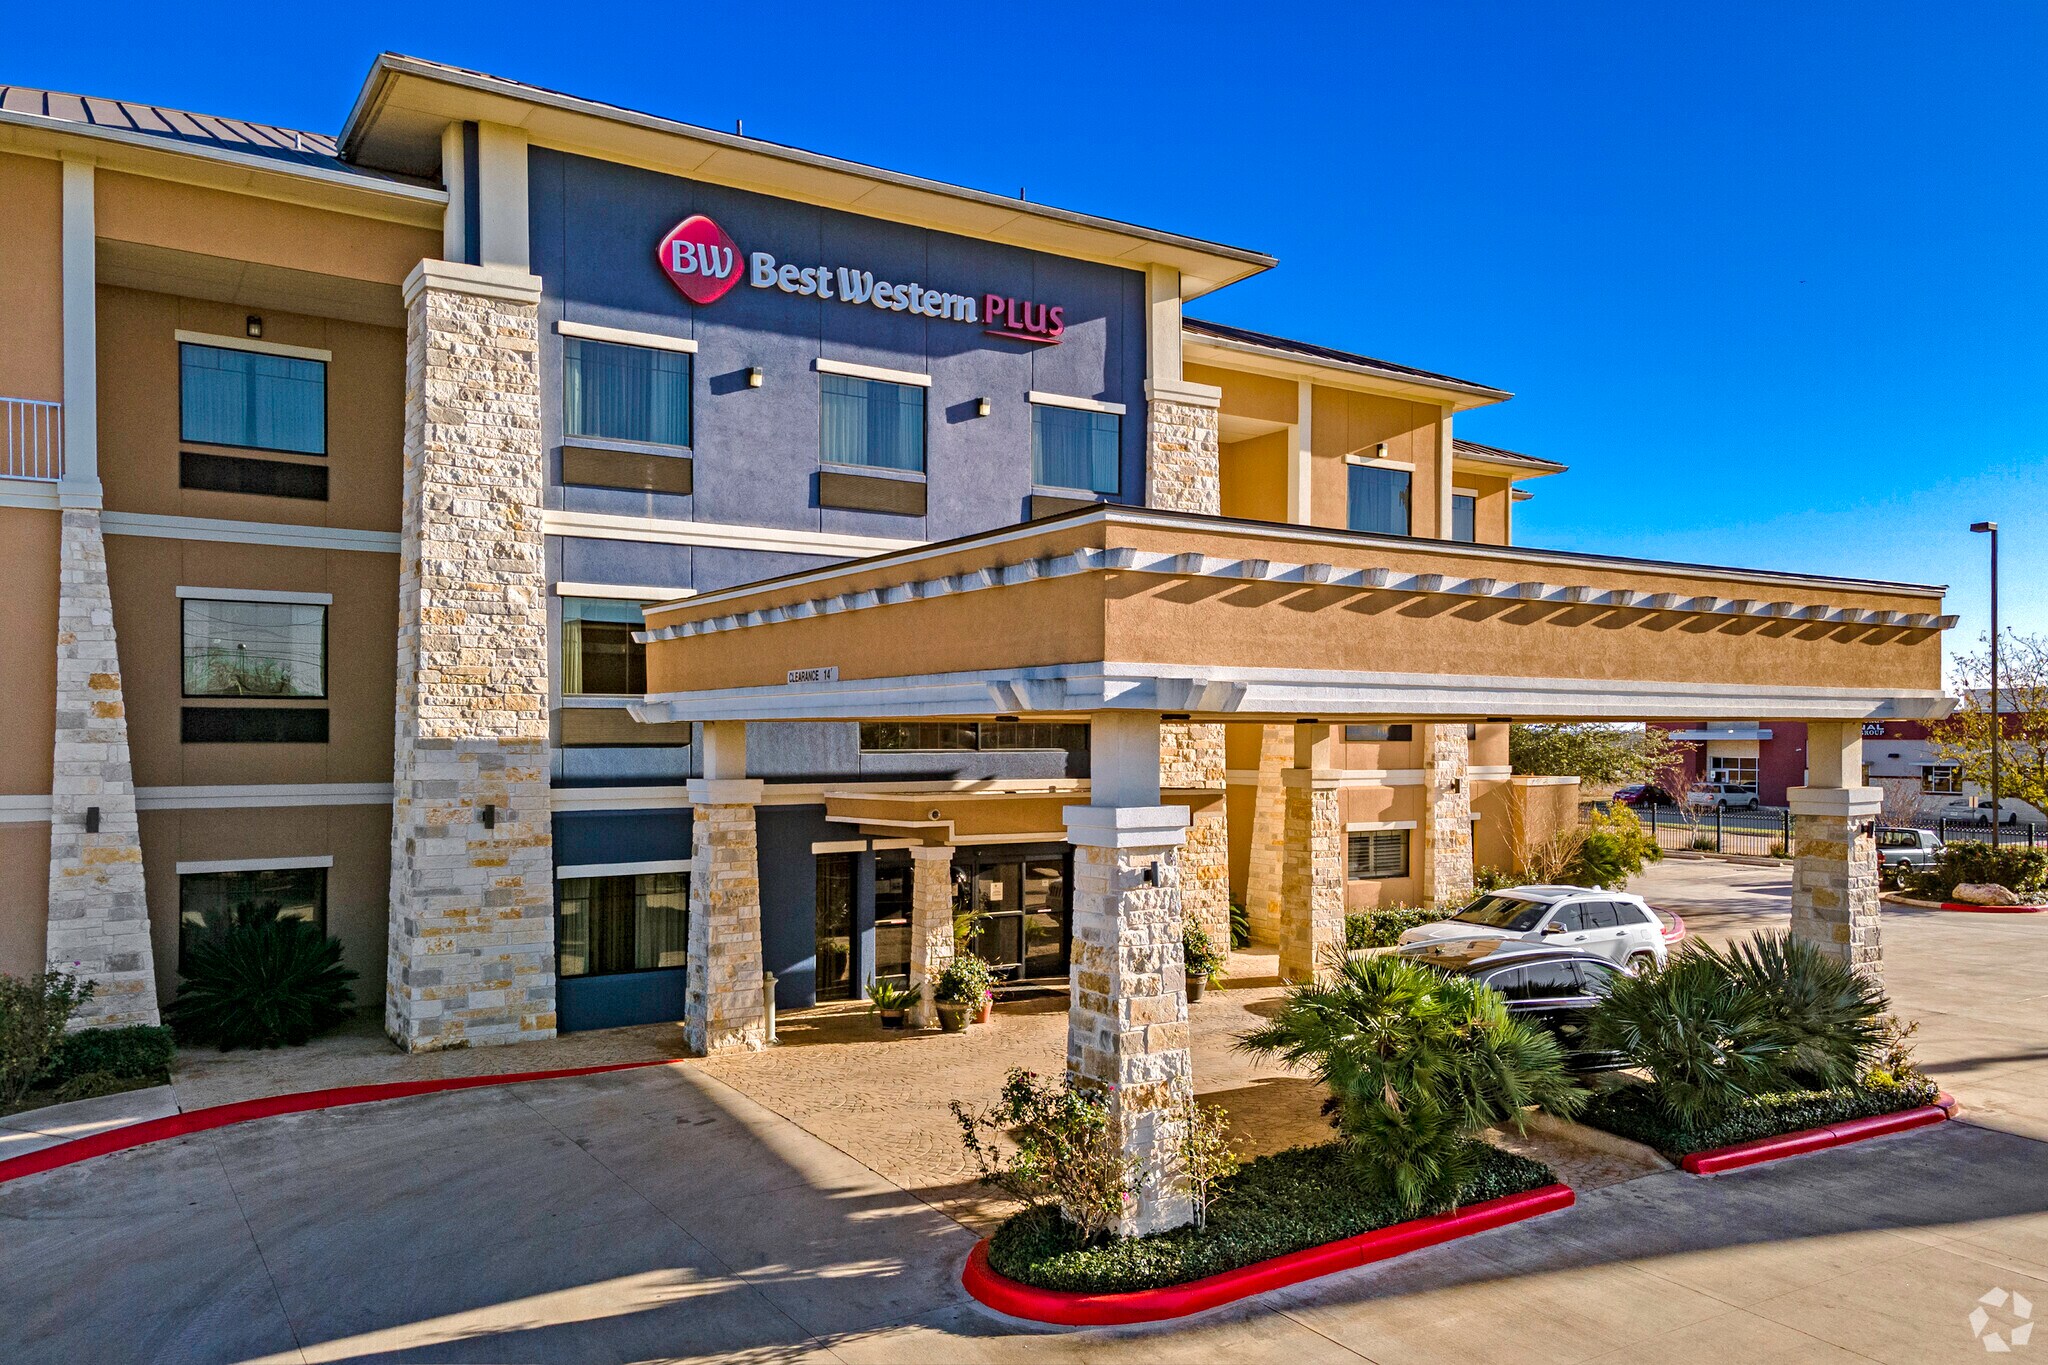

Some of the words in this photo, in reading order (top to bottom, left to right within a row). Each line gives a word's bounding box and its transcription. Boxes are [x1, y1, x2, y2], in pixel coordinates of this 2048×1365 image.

[672, 239, 734, 279] BW
[750, 252, 834, 299] Best
[836, 266, 978, 323] Western
[983, 293, 1065, 336] PLUS
[788, 669, 819, 683] CLEARANCE
